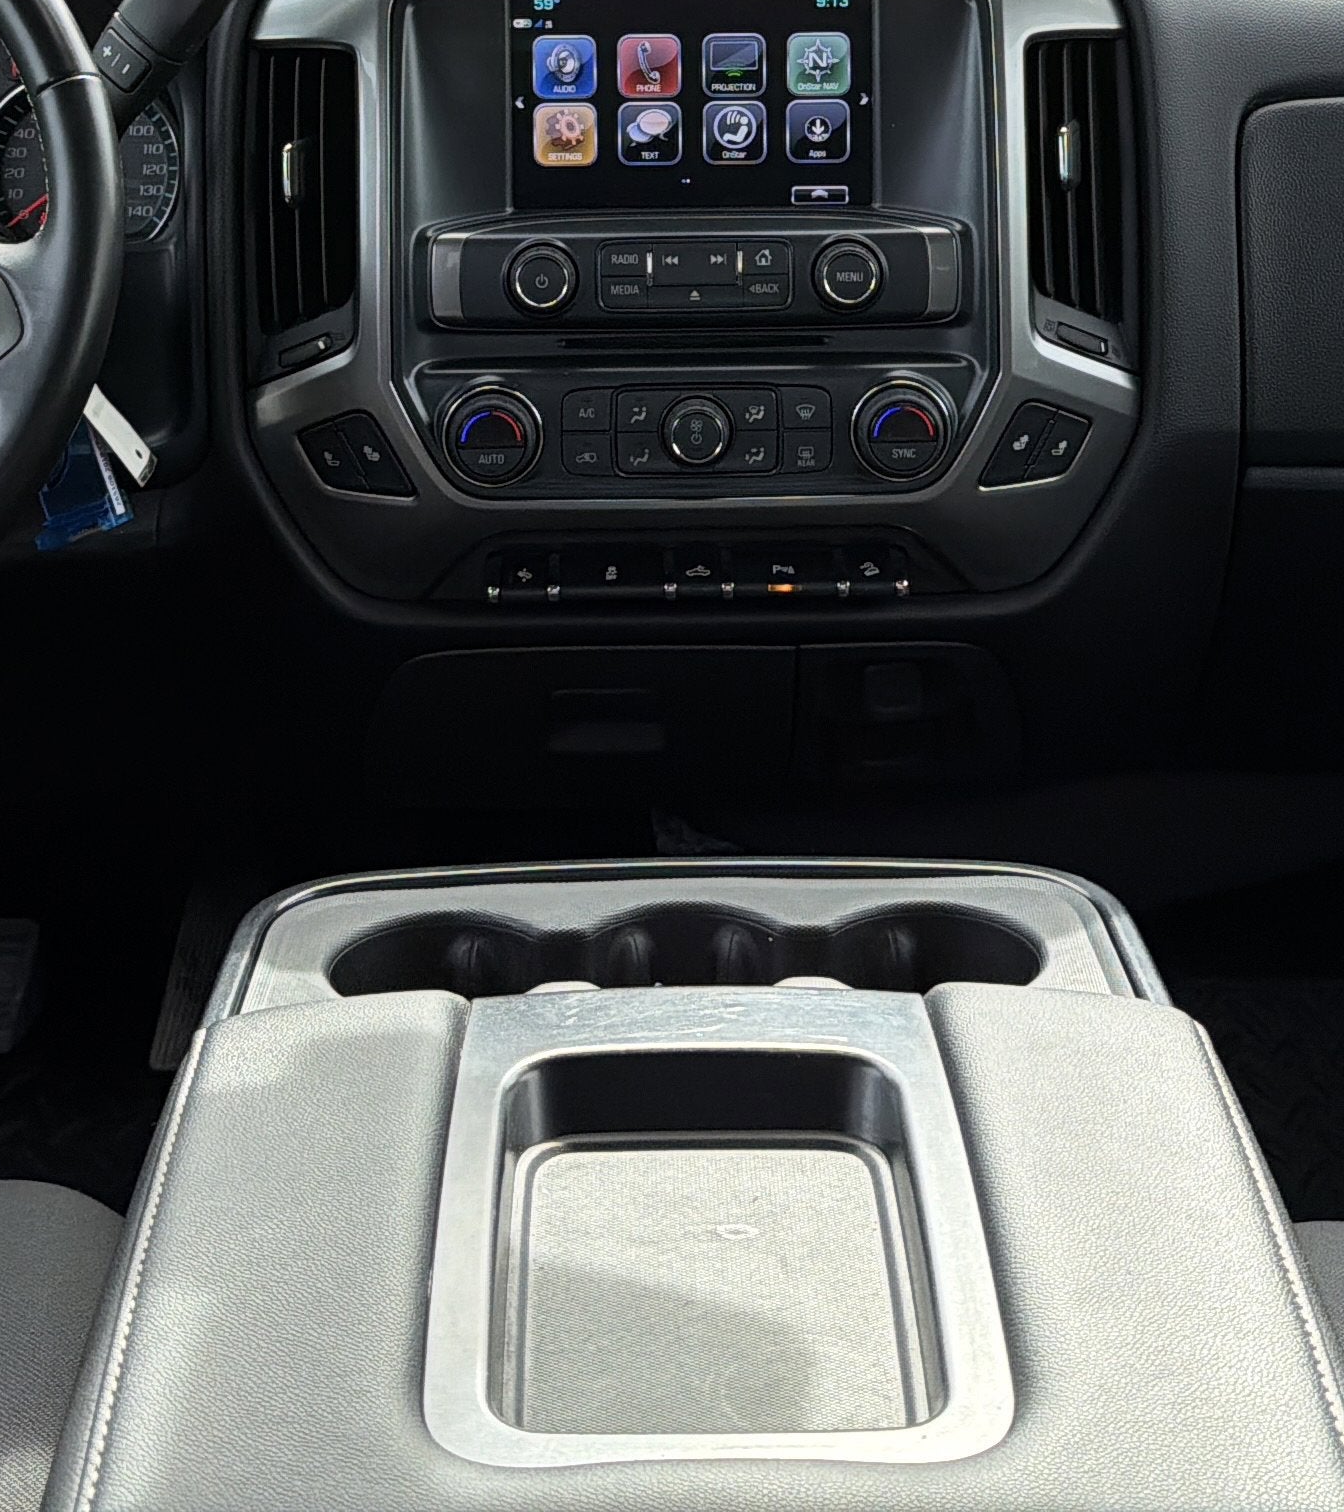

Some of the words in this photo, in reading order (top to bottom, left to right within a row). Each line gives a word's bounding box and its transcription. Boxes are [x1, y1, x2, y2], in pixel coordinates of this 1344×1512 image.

[552, 85, 577, 94] AUDIO
[635, 83, 662, 93] PHONE
[711, 82, 756, 92] PROJECTION
[797, 82, 822, 91] OnStar
[823, 82, 840, 91] NAV
[13, 127, 36, 139] 40
[128, 124, 155, 136] 100
[7, 146, 28, 158] 30
[142, 143, 164, 155] 110
[721, 150, 748, 160] OnStar
[808, 148, 827, 160] Apps
[547, 151, 584, 162] SETTINGS
[640, 151, 660, 161] TEXT
[4, 167, 25, 179] 20
[141, 163, 167, 175] 120
[8, 188, 24, 200] 10
[138, 184, 164, 196] 130
[127, 205, 154, 217] 140
[610, 254, 639, 265] RADIO
[835, 271, 864, 283] MENU
[610, 284, 640, 295] MEDIA
[755, 282, 780, 294] BACK
[578, 407, 596, 419] A/C
[477, 453, 505, 465] AUTO
[891, 448, 917, 459] SYNC
[797, 458, 816, 467] REAR
